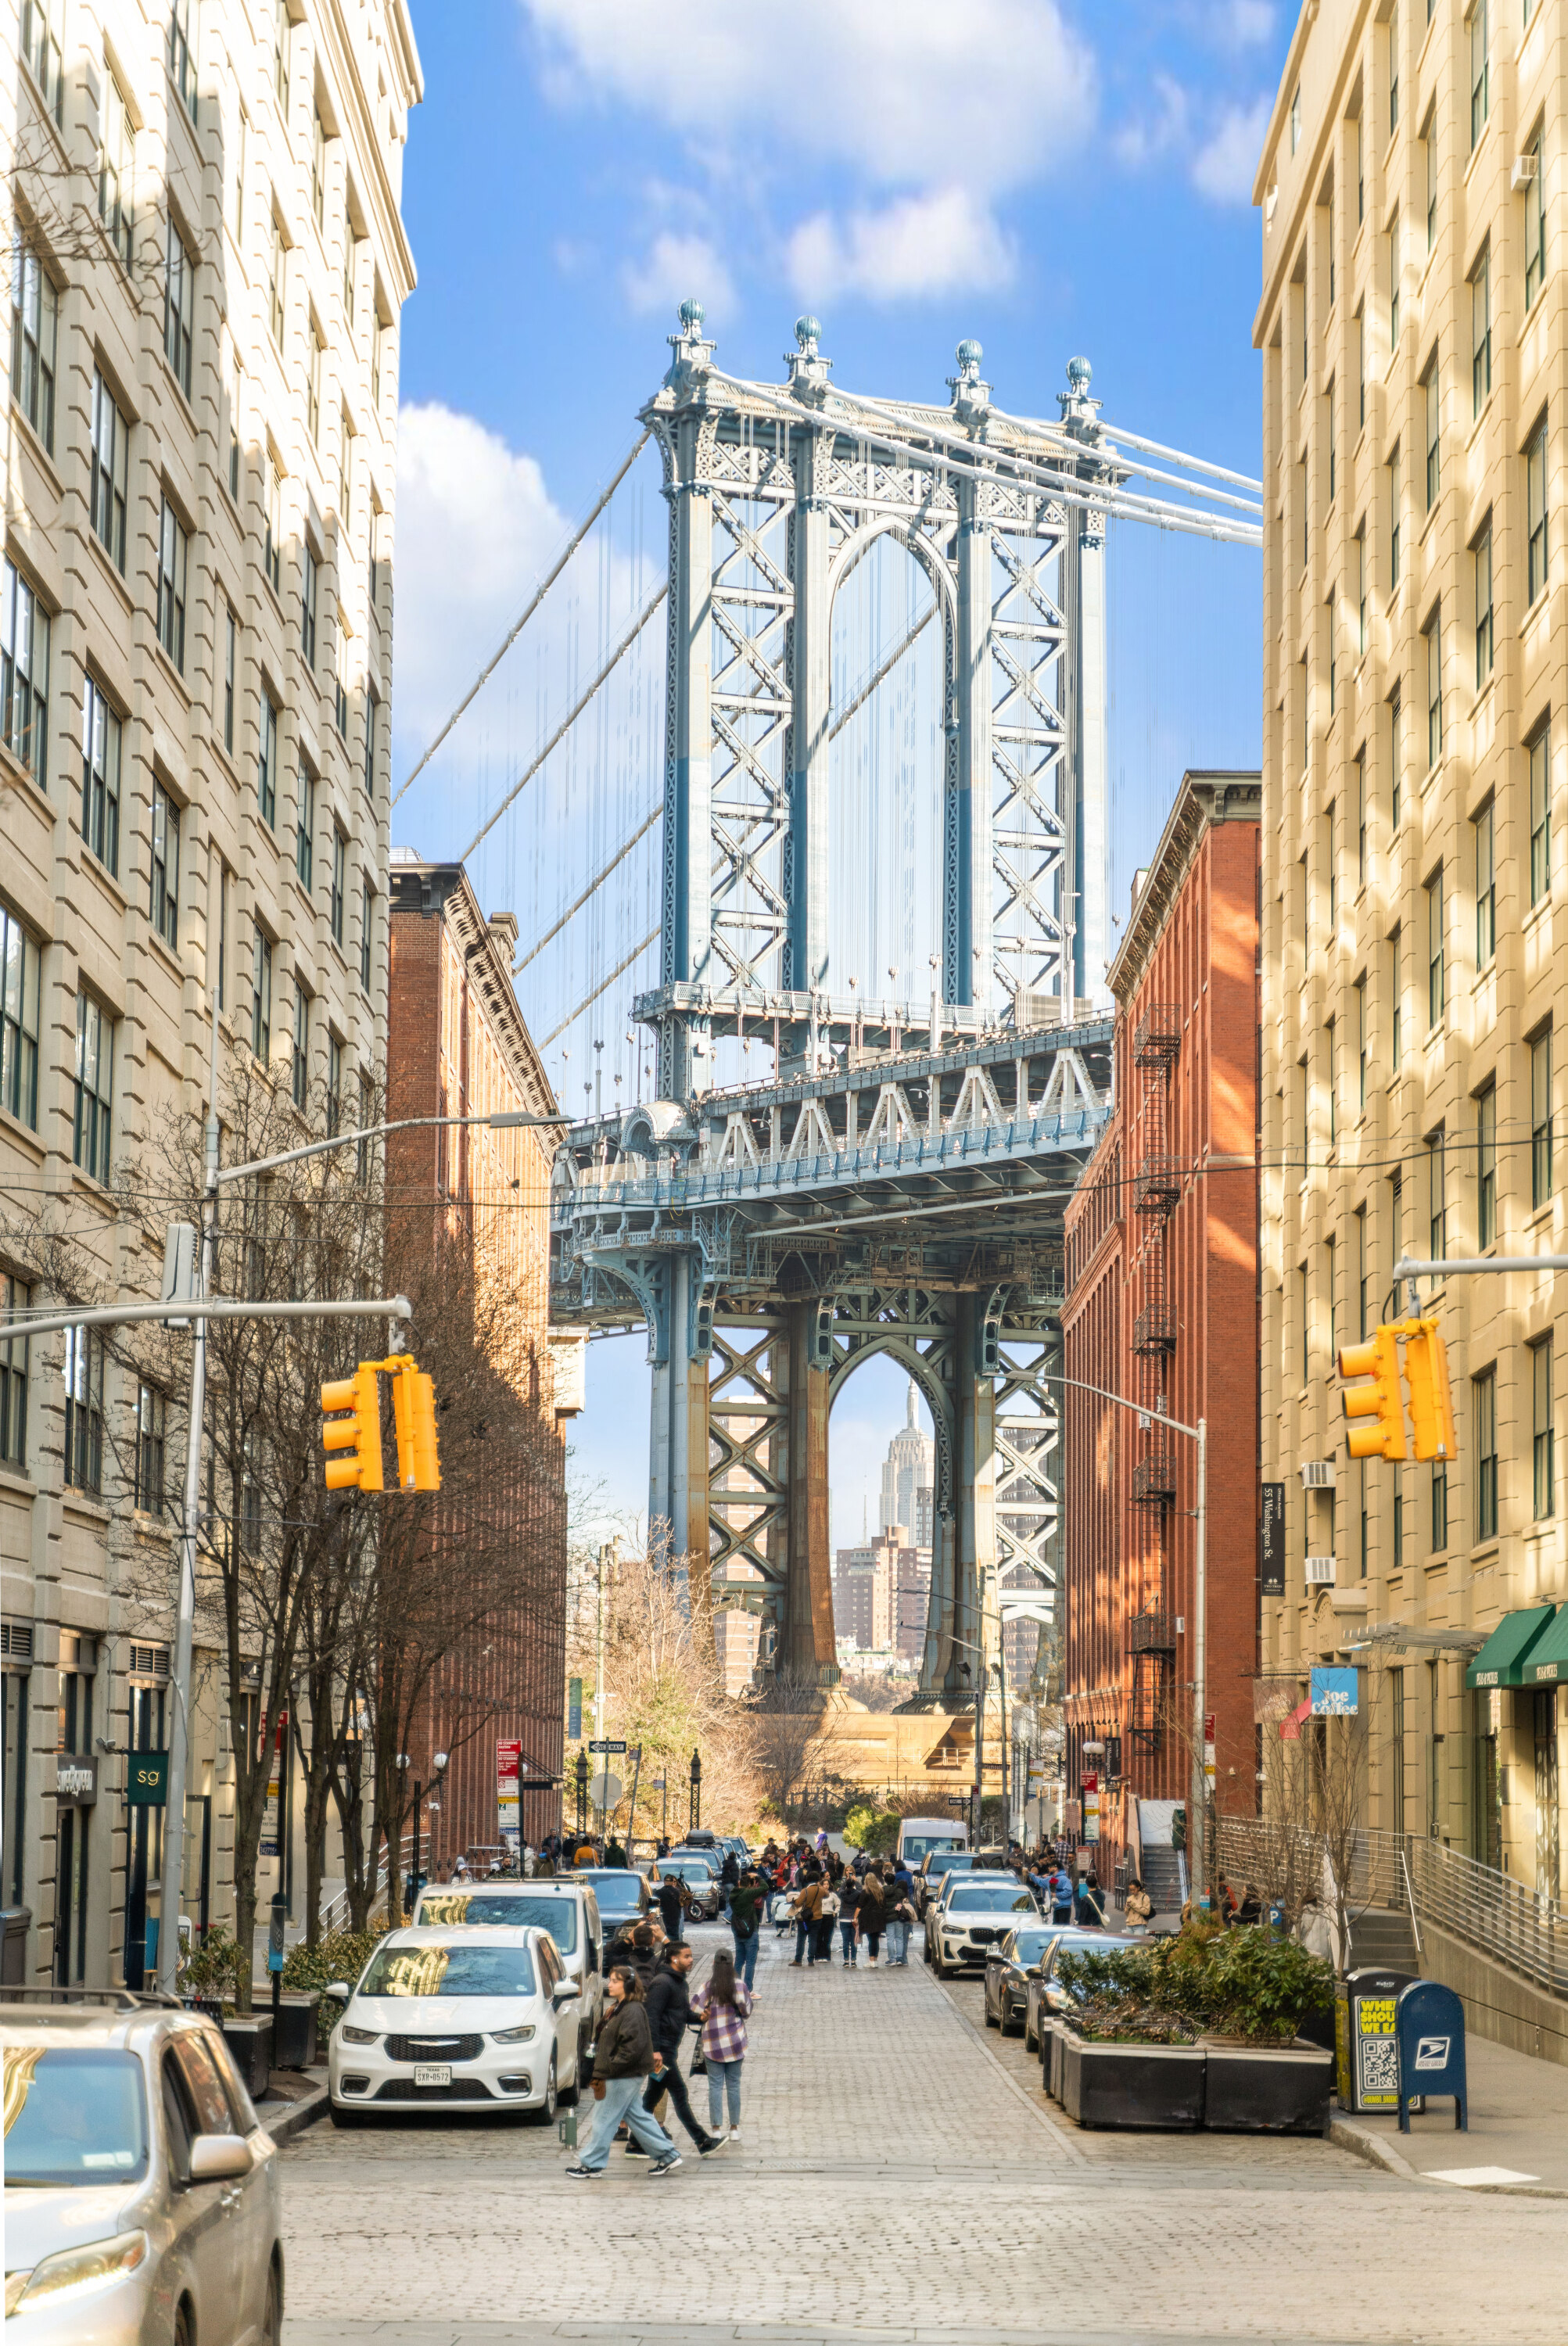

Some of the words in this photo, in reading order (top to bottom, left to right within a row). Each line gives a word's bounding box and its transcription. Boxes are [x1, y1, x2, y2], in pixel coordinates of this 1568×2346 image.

[1265, 1488, 1273, 1498] 55
[1262, 1499, 1273, 1547] Washington
[1264, 1549, 1273, 1560] St.
[1321, 1690, 1349, 1705] Joe
[1311, 1702, 1358, 1715] Coffee
[137, 1770, 160, 1786] sg
[1270, 1910, 1279, 1924] P
[1361, 2000, 1396, 2011] WHE
[1360, 2011, 1395, 2023] SHOU
[1361, 2023, 1380, 2034] WE
[1382, 2023, 1396, 2034] EA
